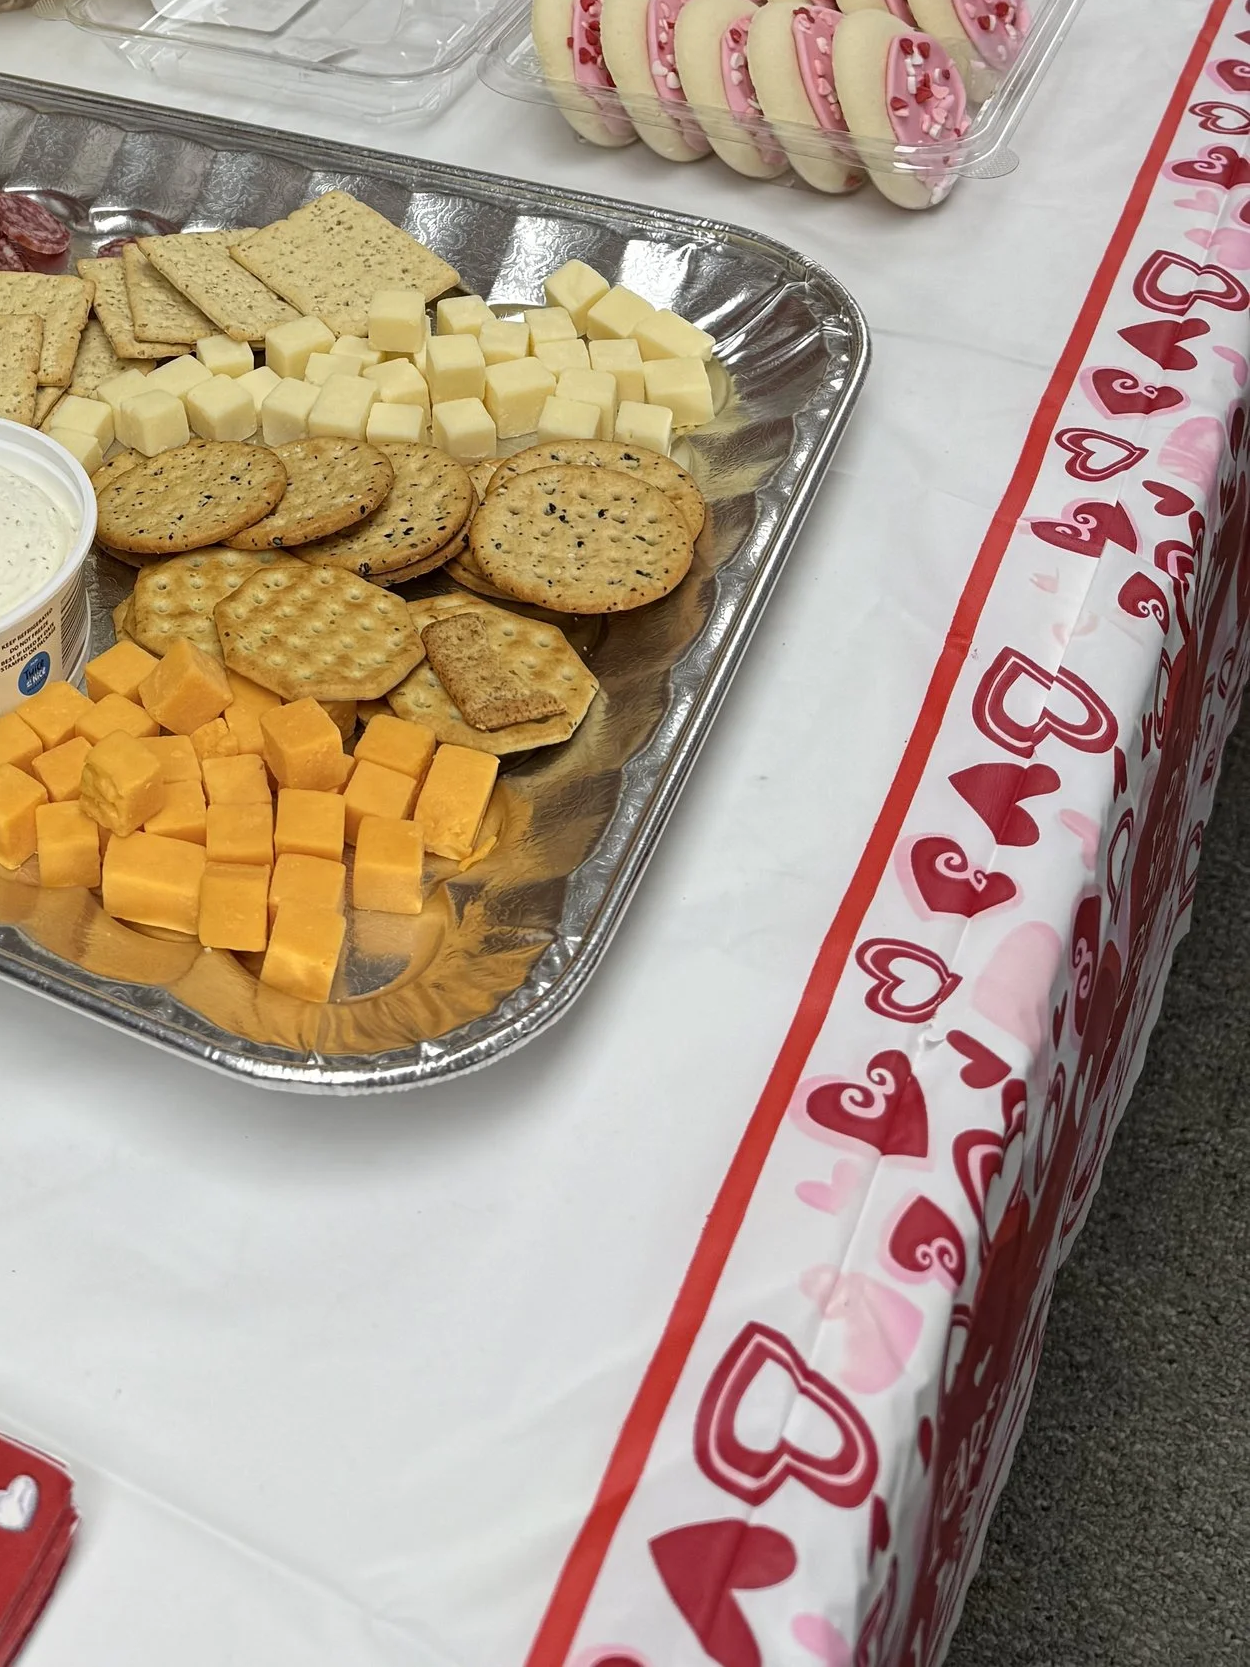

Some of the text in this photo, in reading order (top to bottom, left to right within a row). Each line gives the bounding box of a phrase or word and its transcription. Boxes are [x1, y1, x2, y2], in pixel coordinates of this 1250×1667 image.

[1, 638, 16, 650] KEEP
[10, 645, 19, 654] DO
[20, 636, 32, 648] NOT
[0, 654, 28, 672] STAMPED
[1, 655, 15, 667] BEST
